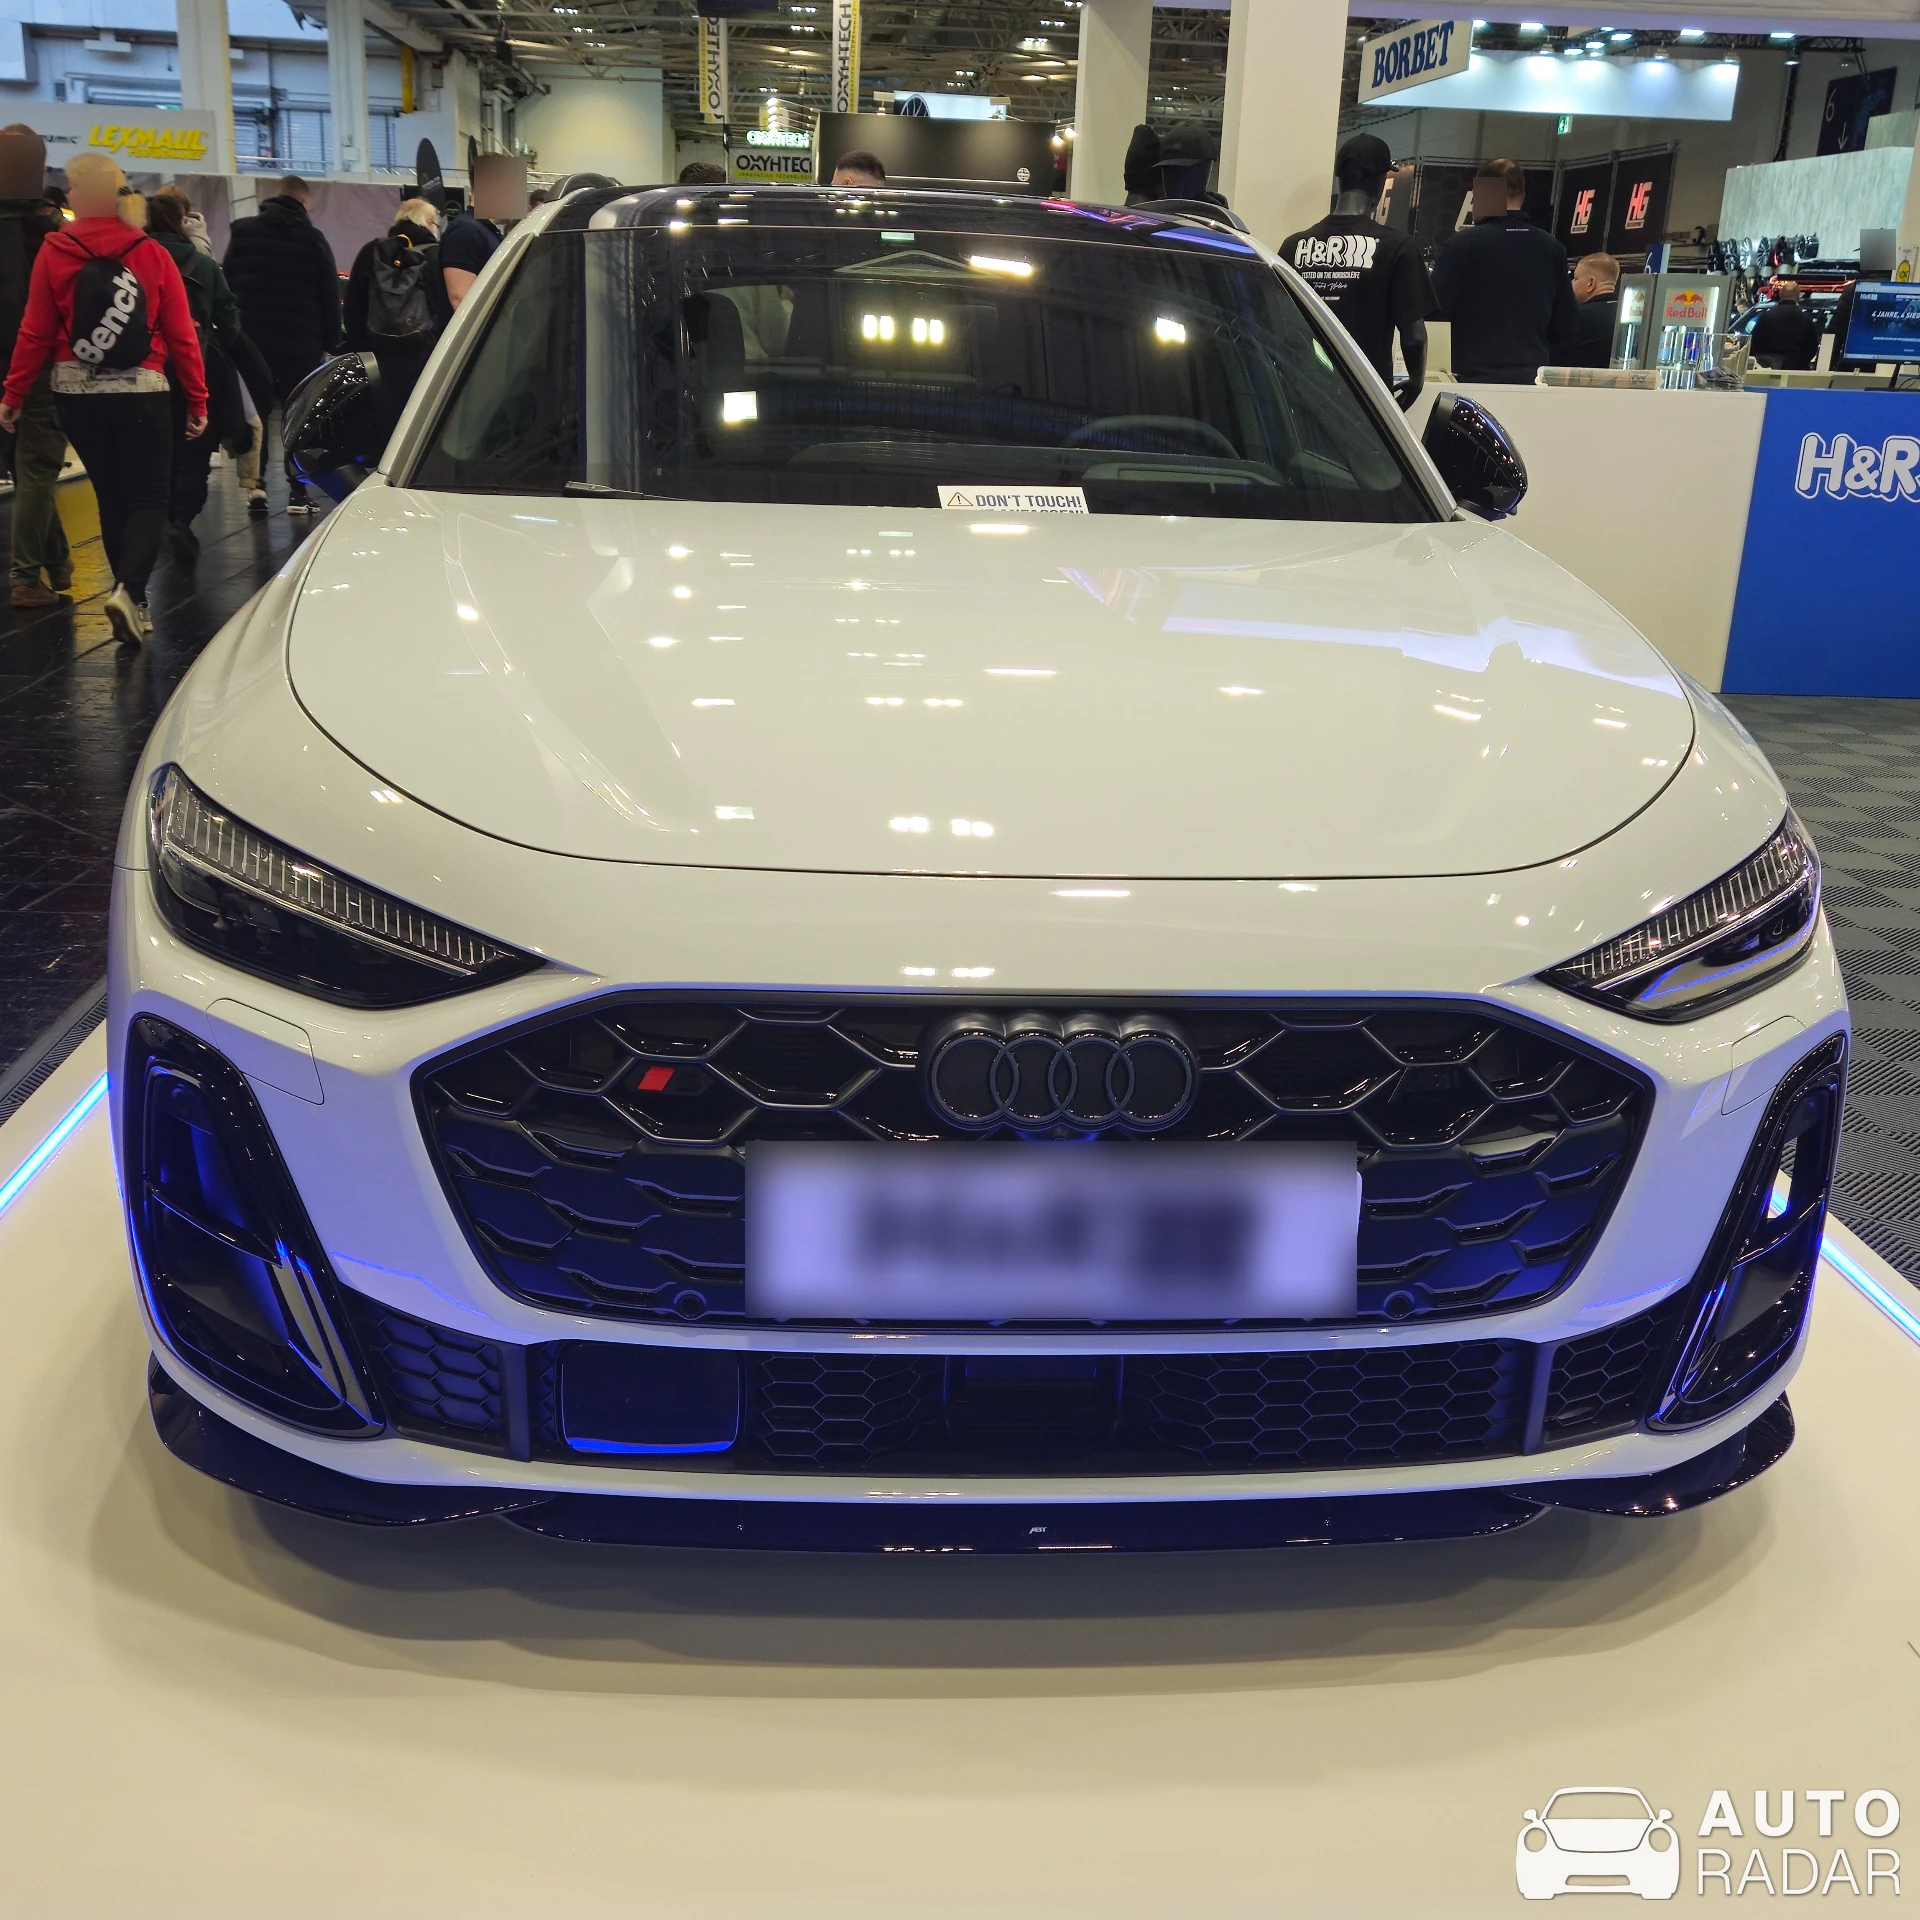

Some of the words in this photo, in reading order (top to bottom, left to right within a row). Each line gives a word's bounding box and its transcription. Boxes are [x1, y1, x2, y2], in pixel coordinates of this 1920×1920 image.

[838, 4, 851, 112] OXYHTECH
[1372, 20, 1454, 88] BORBET
[1826, 88, 1837, 122] 6
[88, 124, 208, 154] LEXMAUL
[1370, 178, 1395, 225] G
[1571, 189, 1596, 228] HG
[1626, 182, 1653, 222] HG
[1294, 235, 1347, 268] H&R
[1644, 252, 1653, 274] 6
[72, 266, 139, 365] Bench
[1665, 307, 1686, 318] Red
[1687, 307, 1708, 319] Bull
[1795, 432, 1920, 503] H&R
[975, 494, 1021, 507] DON'T
[1025, 495, 1082, 508] TOUCH!
[1029, 1526, 1047, 1534] ABT
